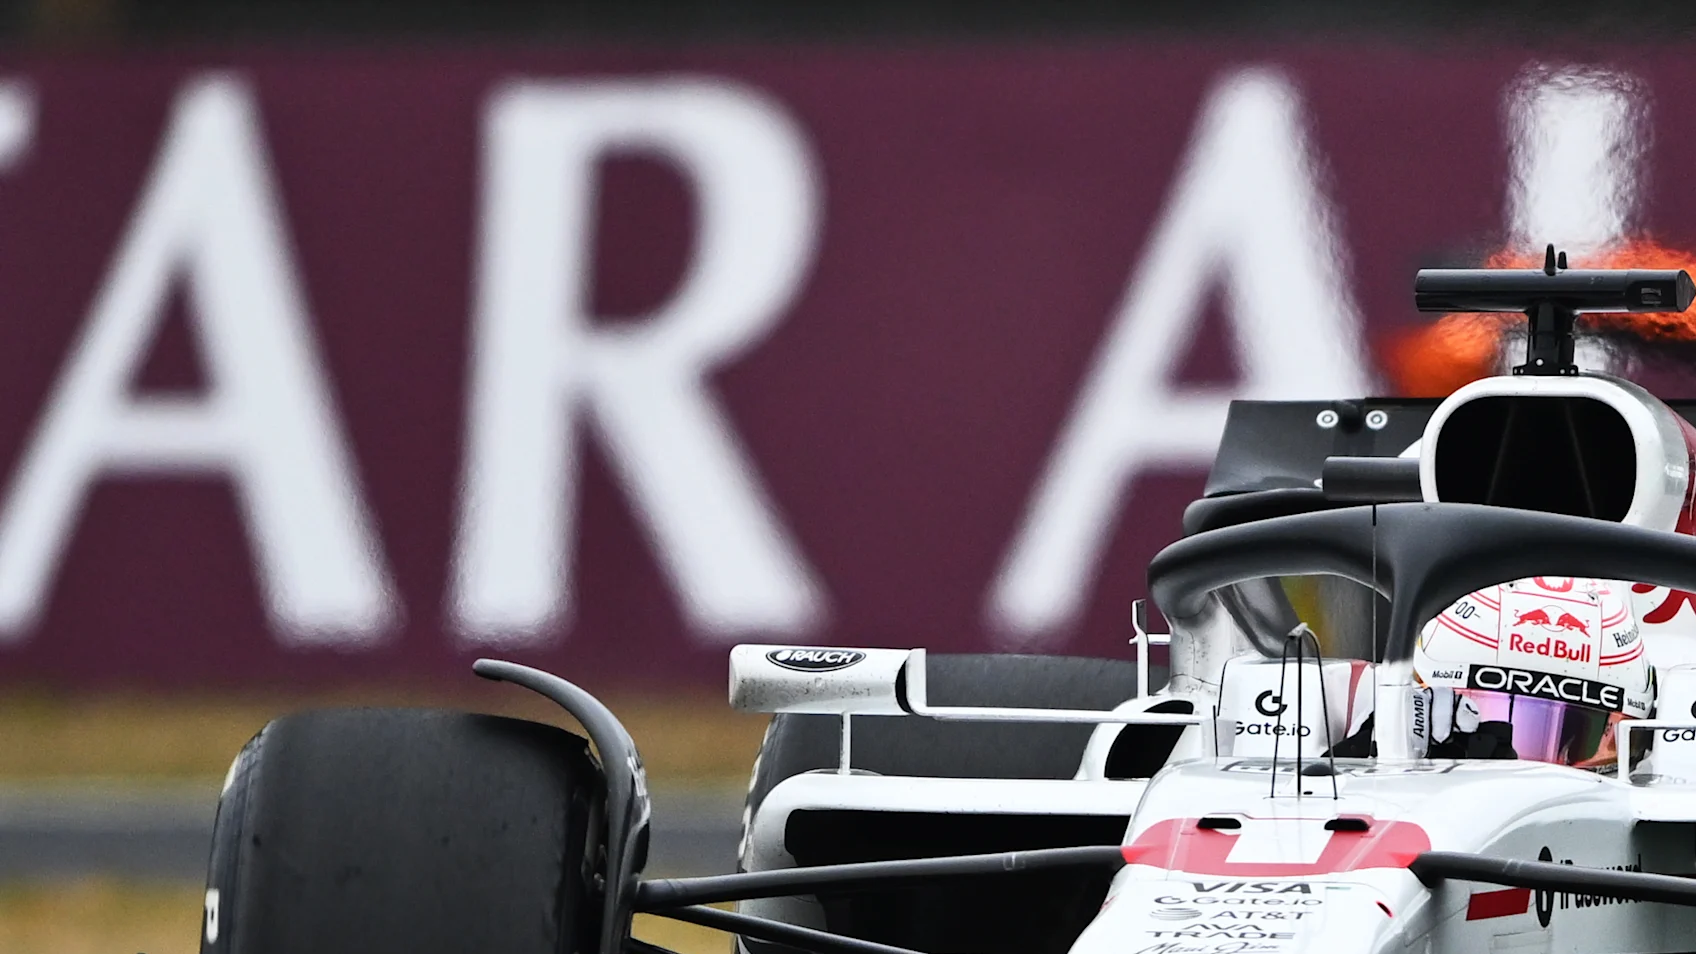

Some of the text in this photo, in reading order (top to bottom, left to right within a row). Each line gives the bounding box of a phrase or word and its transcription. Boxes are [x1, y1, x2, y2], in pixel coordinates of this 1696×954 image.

[0, 68, 832, 648] AR
[1509, 633, 1591, 663] Red Bull
[790, 650, 856, 664] RAUCH
[1431, 670, 1455, 679] Mobil
[1474, 666, 1620, 709] ORACLE
[1235, 720, 1312, 738] Gate.io
[1192, 882, 1313, 895] VISA
[1191, 896, 1324, 906] Gate.io
[204, 887, 220, 945] P
[1209, 910, 1313, 920] AT&T
[1181, 923, 1264, 931] AVA
[1144, 930, 1297, 940] TRADE
